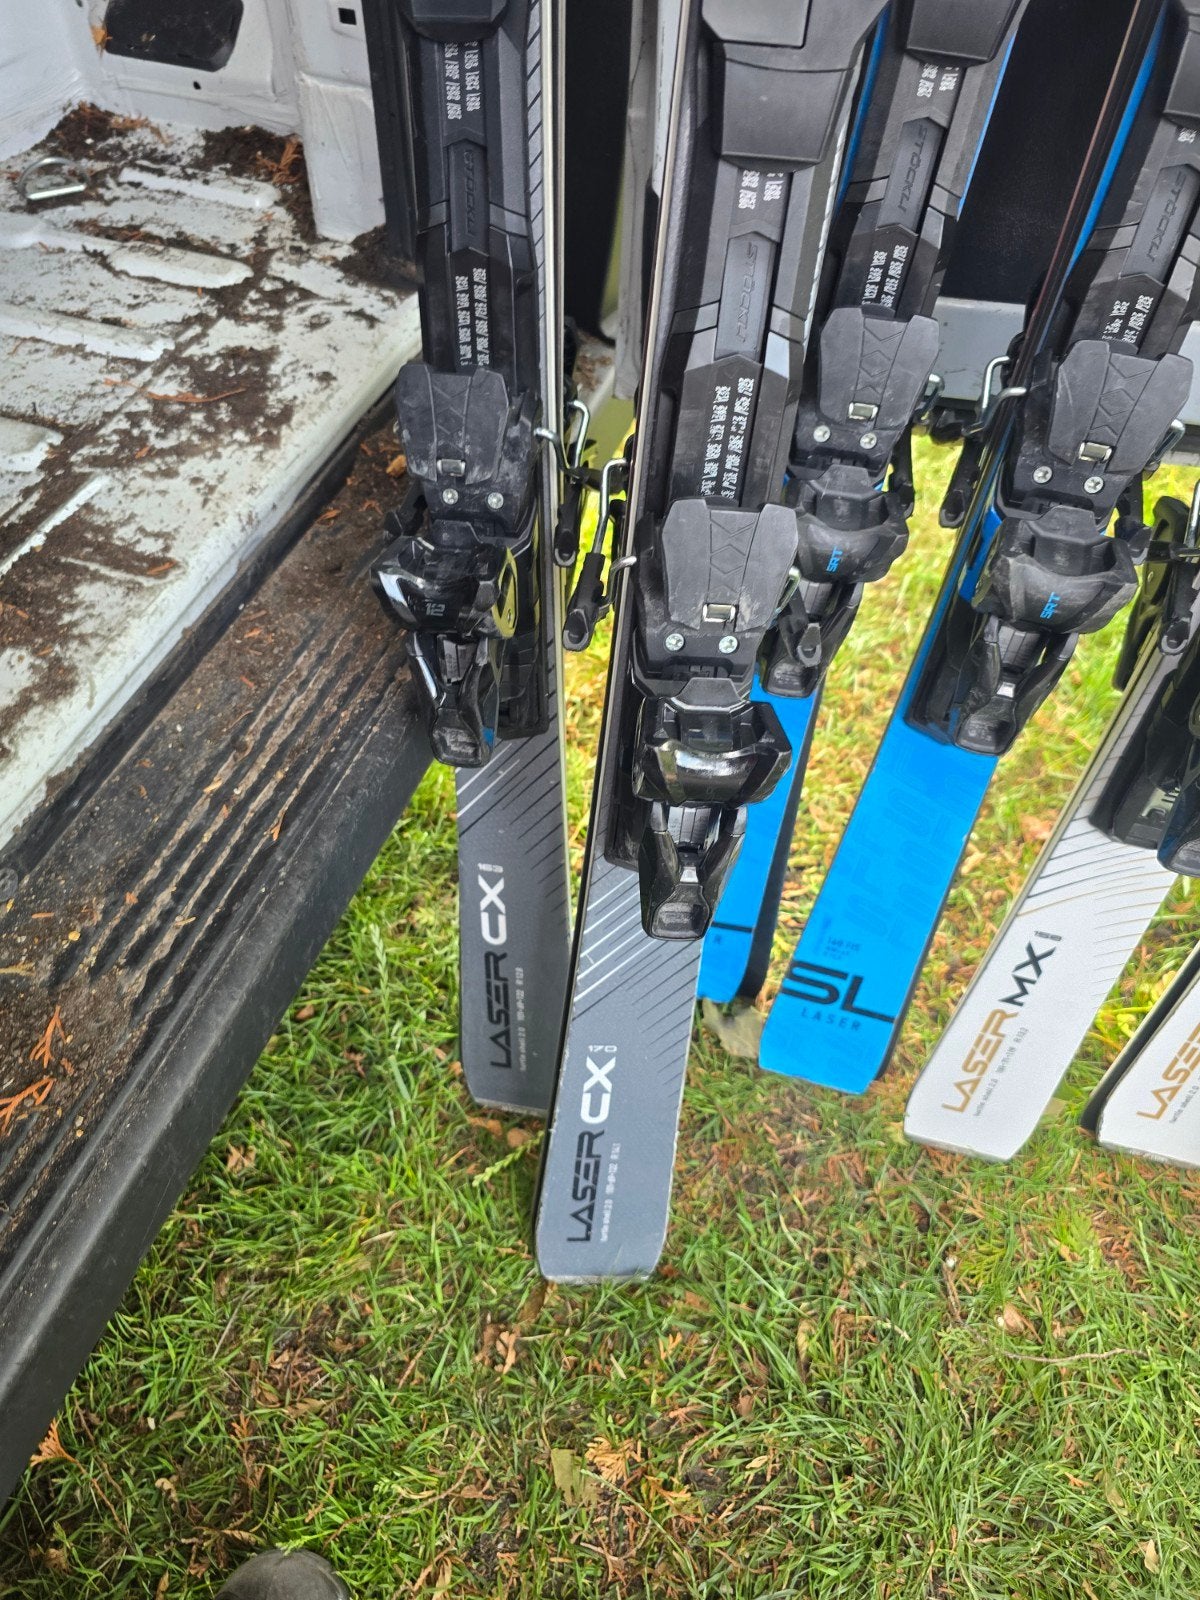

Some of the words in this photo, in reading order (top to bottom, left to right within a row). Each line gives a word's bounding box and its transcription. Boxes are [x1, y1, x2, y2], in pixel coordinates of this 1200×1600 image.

[826, 546, 843, 573] SRT
[1040, 592, 1061, 619] SRT
[477, 876, 507, 946] CX
[484, 951, 512, 1070] LASER
[781, 961, 897, 1024] SL
[801, 1009, 862, 1032] LASER
[942, 1008, 1019, 1113] LASER
[999, 942, 1056, 1007] MX
[587, 1044, 617, 1053] 170
[1136, 1022, 1200, 1120] LASE
[580, 1055, 616, 1125] CX
[567, 1129, 605, 1243] LASER
